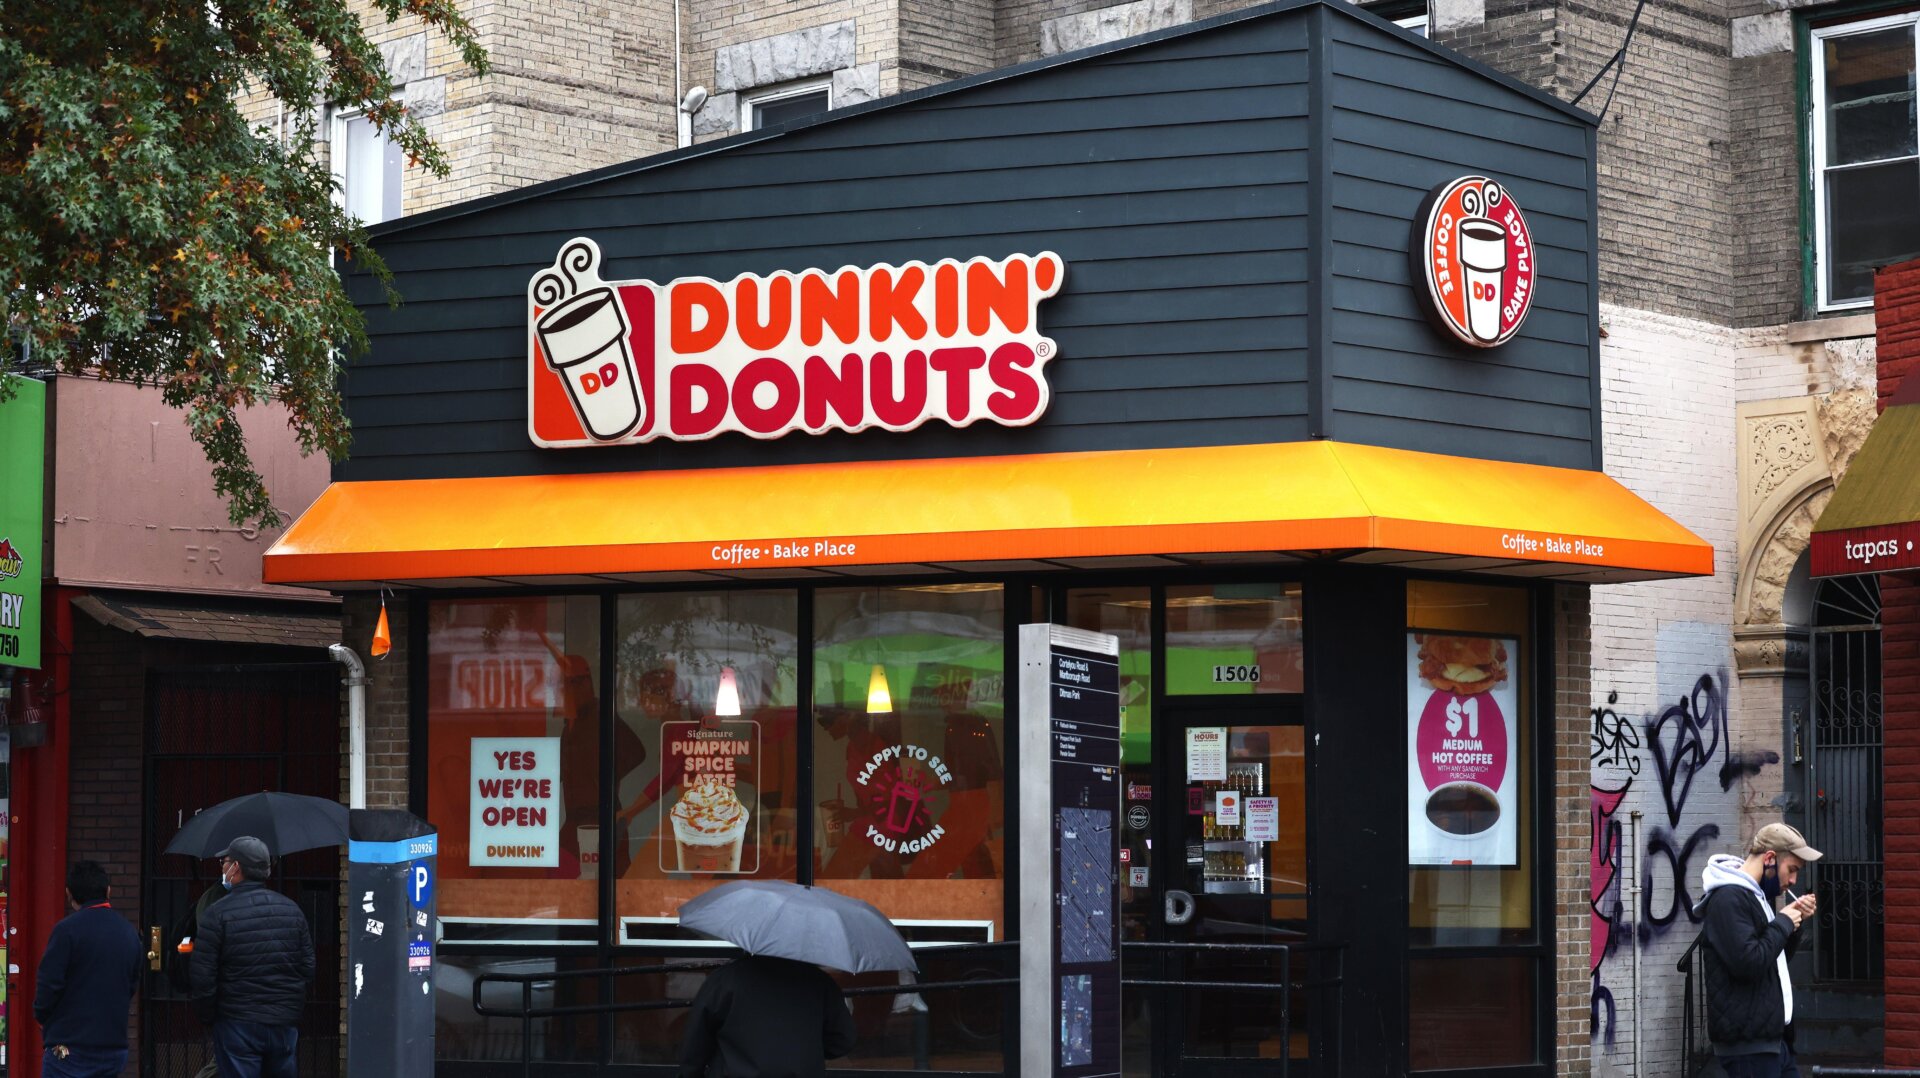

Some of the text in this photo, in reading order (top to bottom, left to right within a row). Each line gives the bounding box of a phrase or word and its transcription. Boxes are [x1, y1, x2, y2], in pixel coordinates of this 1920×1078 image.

[1504, 209, 1529, 272] PLACE
[1436, 213, 1453, 295] COFFEE
[1473, 281, 1495, 302] DD
[1504, 276, 1528, 322] BAKE
[670, 256, 1056, 354] DUNKIN'
[580, 362, 619, 395] DD
[670, 341, 1041, 436] DONUTS
[711, 540, 856, 564] Coffee Bake Place
[1501, 533, 1604, 557] Coffee Bake Place
[1845, 539, 1899, 564] tapas
[1215, 665, 1259, 682] 1506
[1445, 697, 1478, 738] $1
[687, 730, 734, 739] Signature
[1442, 738, 1483, 751] MEDIUM
[671, 740, 750, 755] PUMPKIN
[493, 750, 537, 771] YES
[684, 757, 735, 772] SPICE
[856, 744, 953, 786] HAPPY TO SEE
[1432, 752, 1493, 765] HOT COFFEE
[683, 773, 736, 788] LATTE
[1450, 772, 1476, 780] PURCHASE
[478, 778, 552, 799] WE'RE
[482, 807, 547, 827] OPEN
[410, 842, 433, 854] 330926
[866, 824, 946, 854] YOU AGAIN
[486, 845, 545, 858] DUNKIN'
[581, 852, 600, 864] DD
[415, 866, 428, 902] P
[409, 946, 430, 956] 330926
